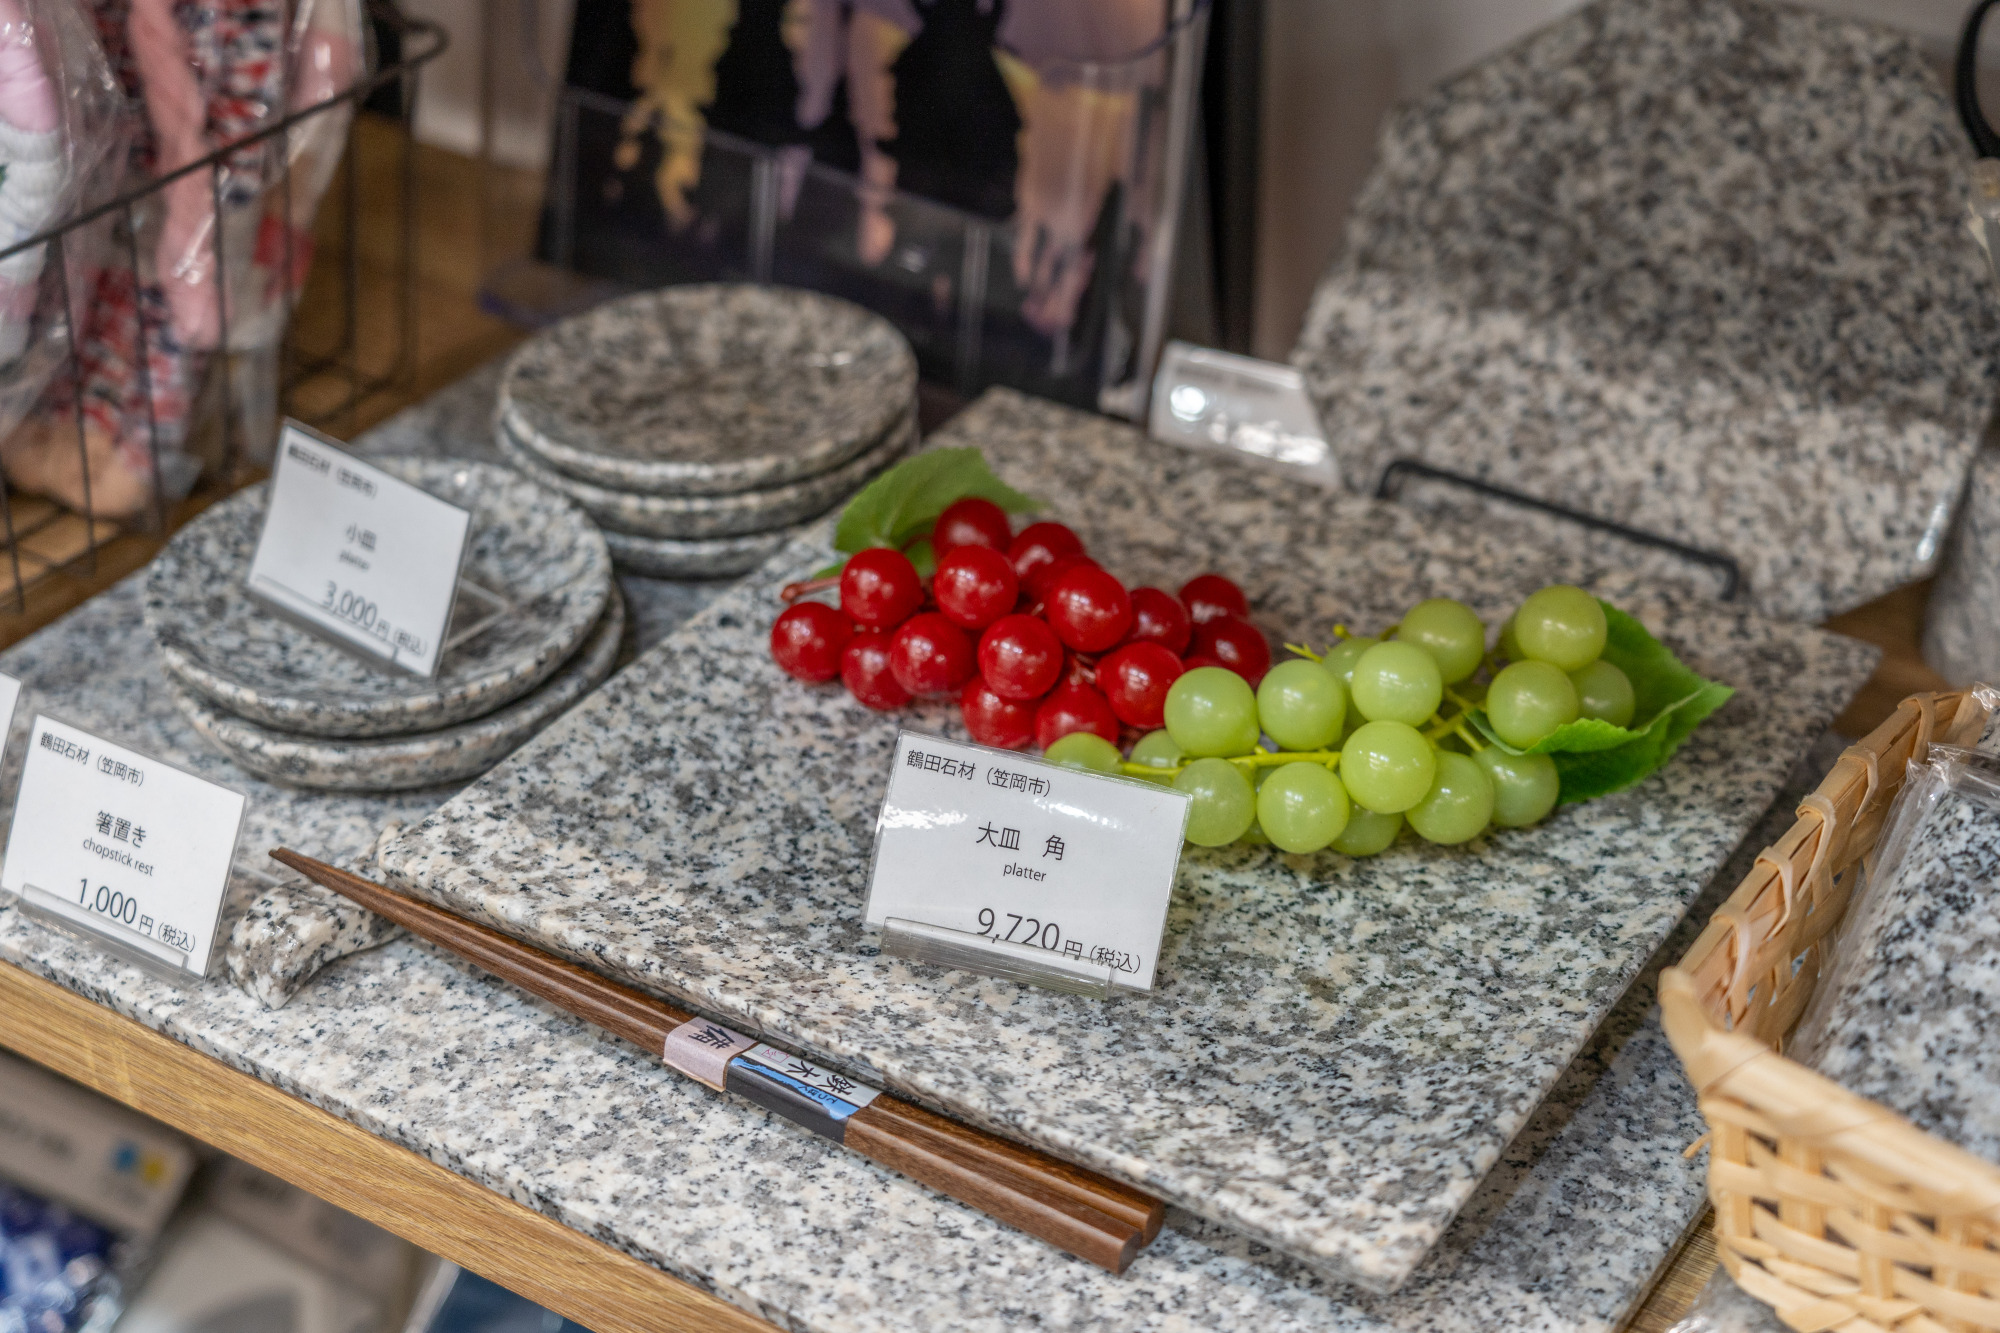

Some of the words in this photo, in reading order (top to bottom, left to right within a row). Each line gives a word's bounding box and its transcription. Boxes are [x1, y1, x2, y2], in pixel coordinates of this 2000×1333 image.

[347, 525, 377, 550] 小皿
[96, 810, 147, 848] 箸置き
[83, 837, 133, 868] chopstick
[134, 860, 155, 877] rest
[1003, 863, 1047, 882] platter
